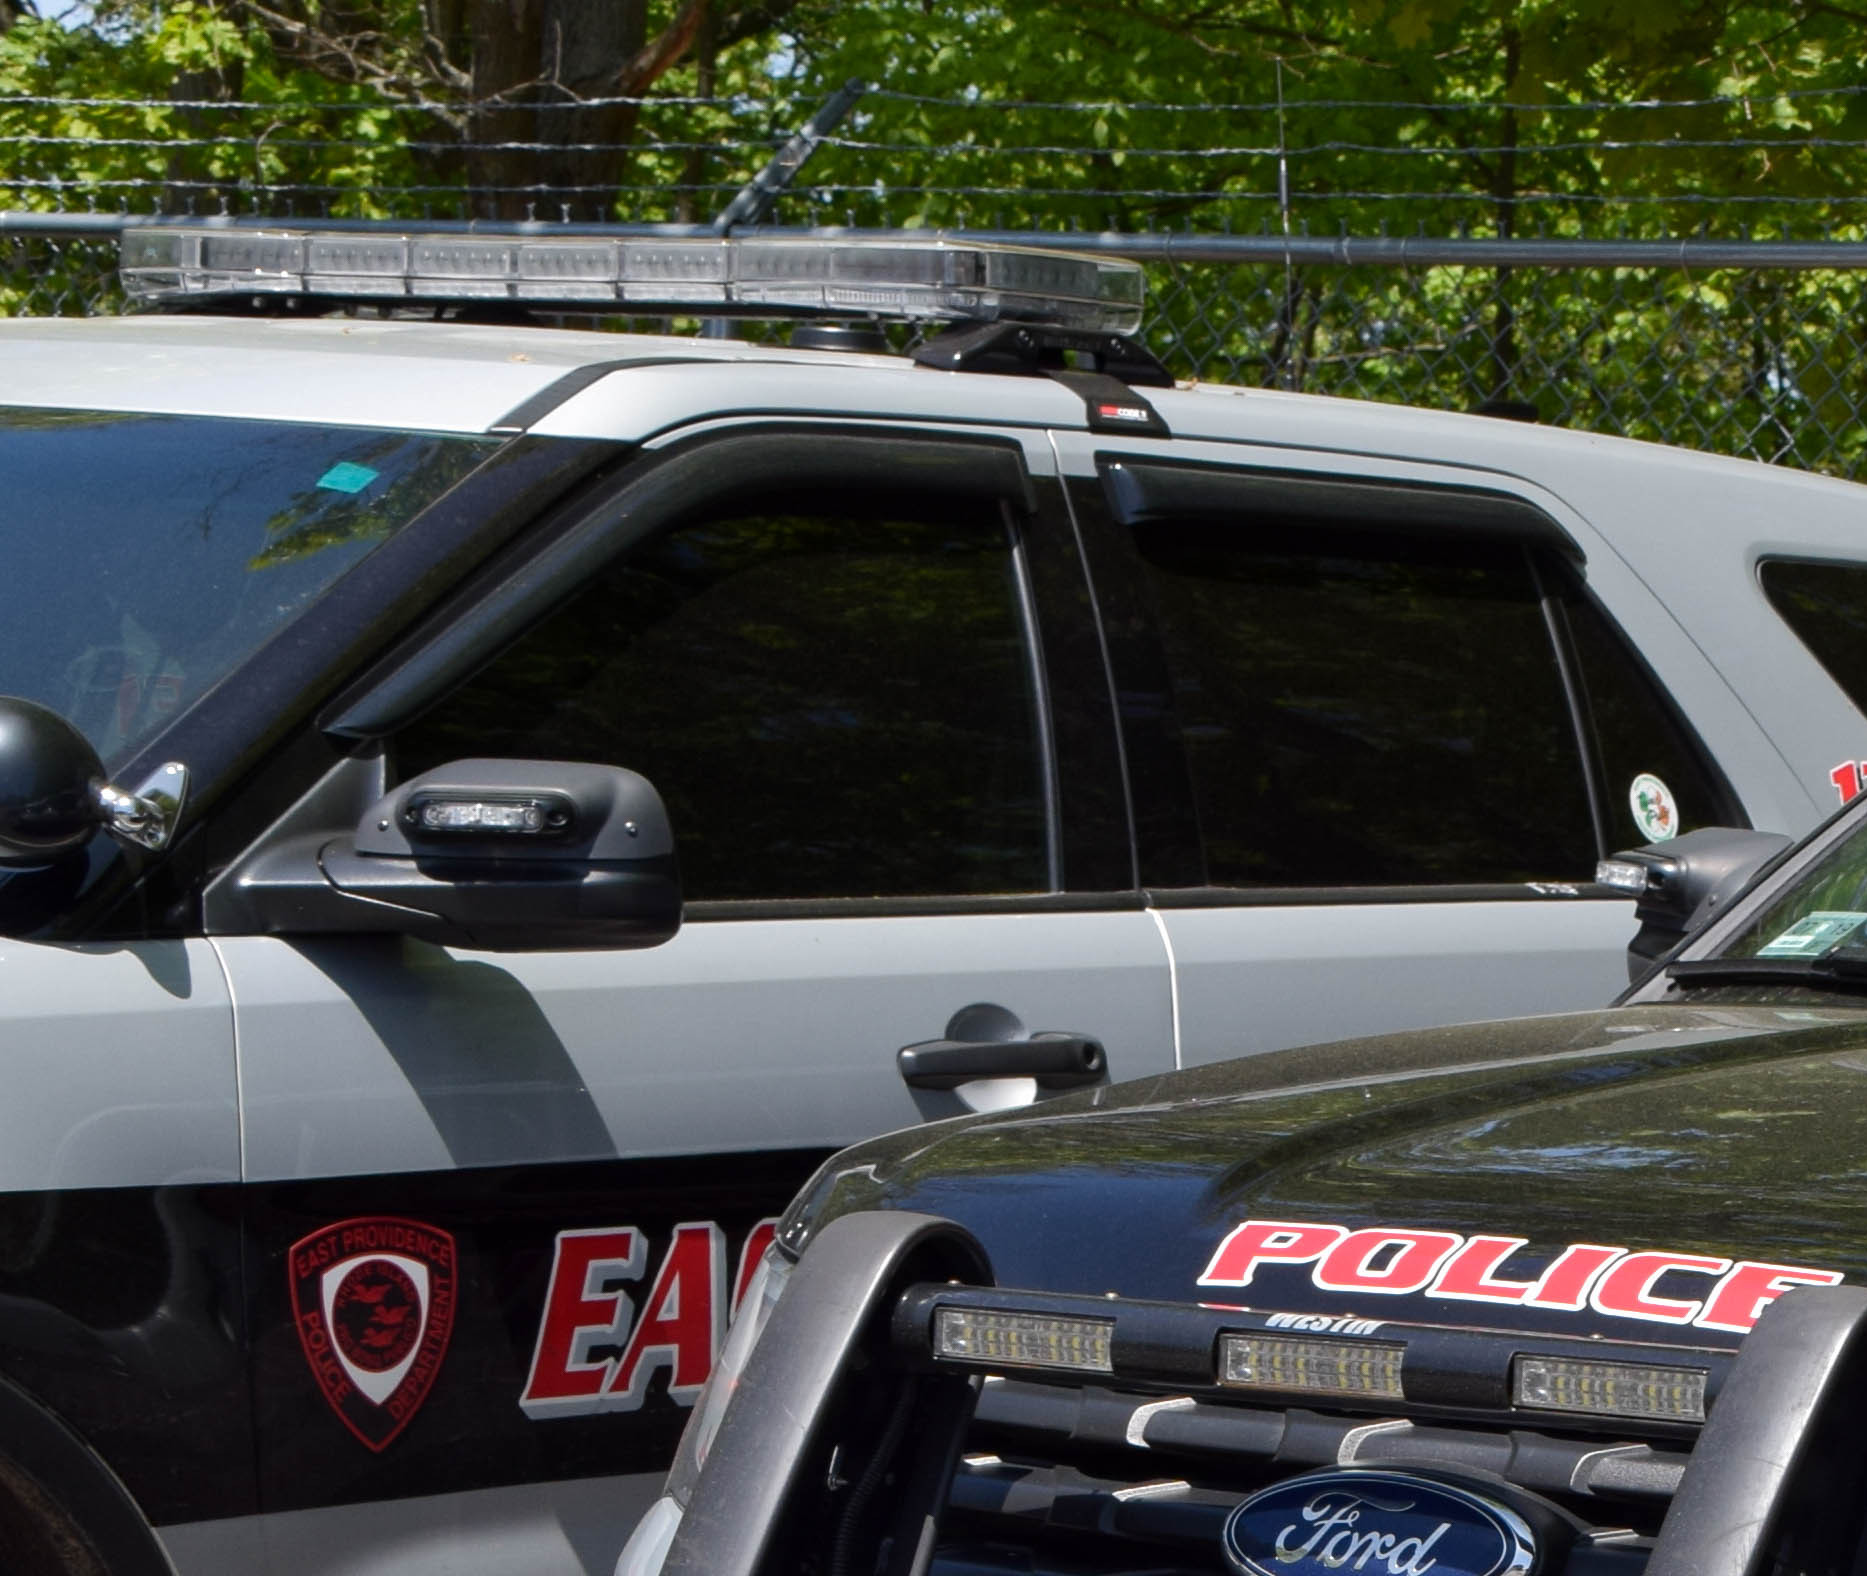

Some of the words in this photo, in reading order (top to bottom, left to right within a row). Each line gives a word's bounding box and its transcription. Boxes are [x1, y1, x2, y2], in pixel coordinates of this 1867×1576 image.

[296, 1236, 337, 1278] EAST
[343, 1226, 450, 1266] PROVIDENCE
[1197, 1220, 1844, 1333] POLICE
[302, 1312, 351, 1402] POLICE
[388, 1274, 448, 1418] DEPARTMENT
[1275, 1491, 1451, 1576] Ford
